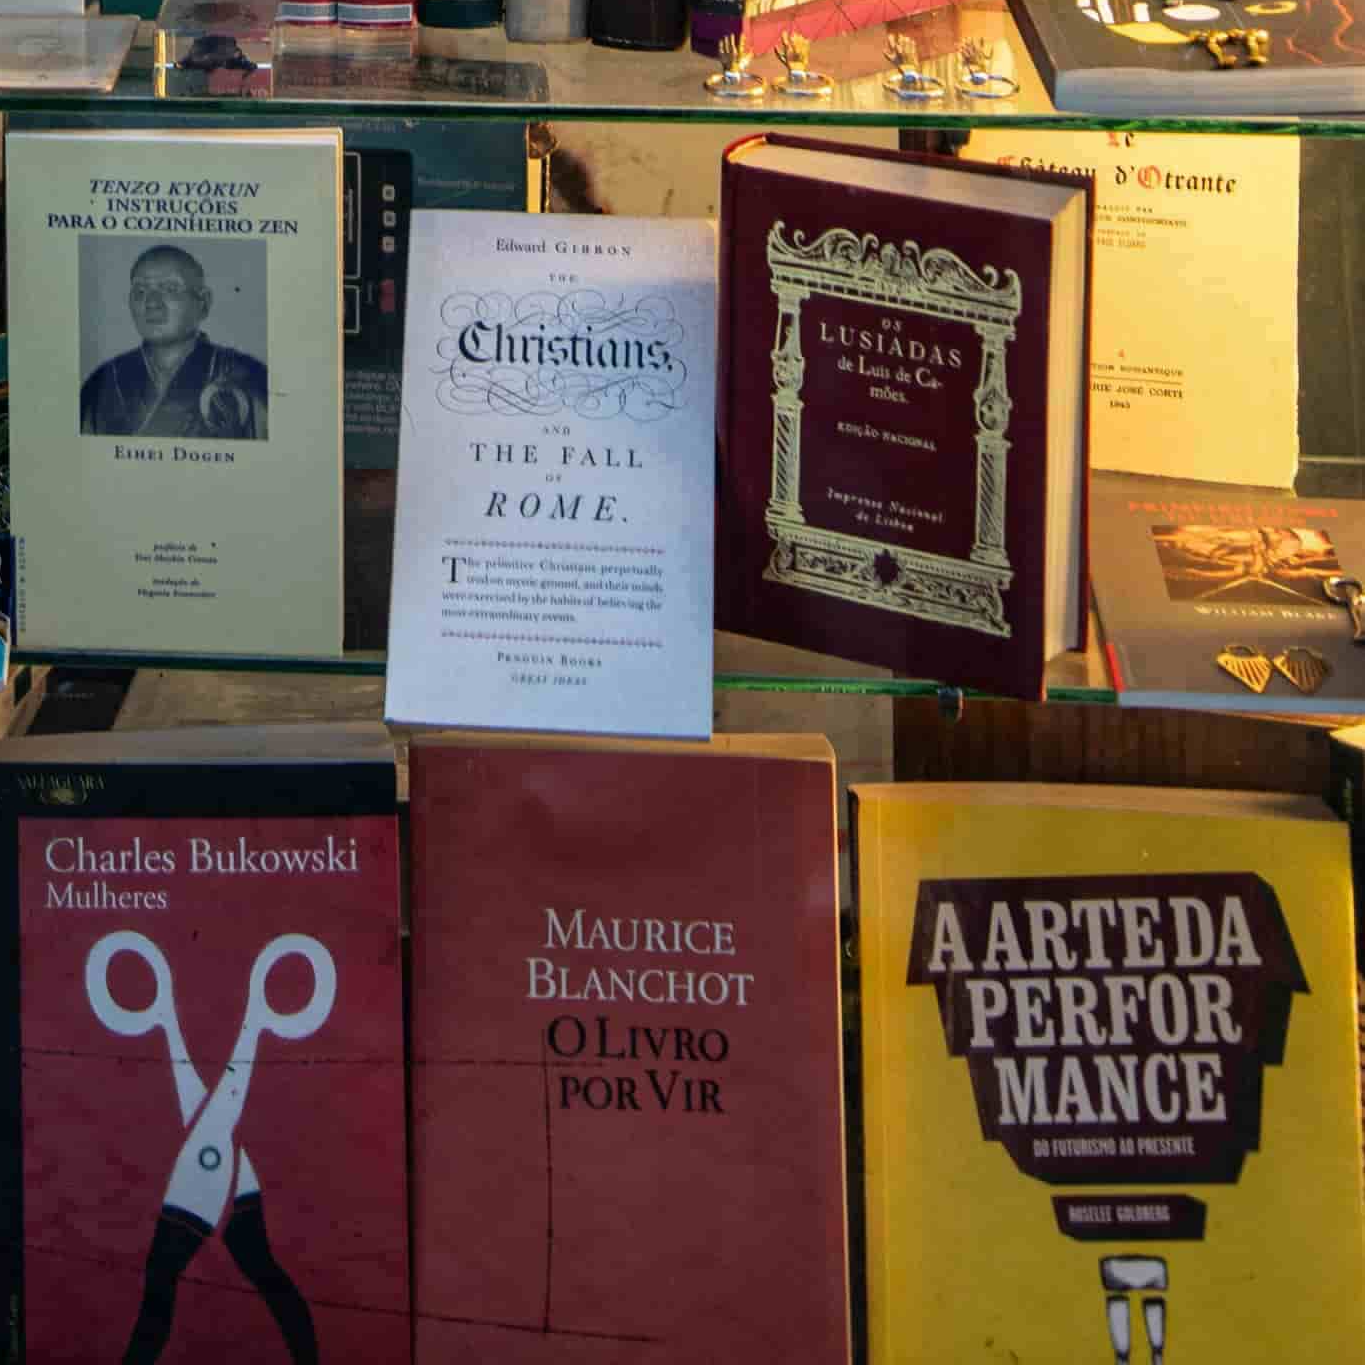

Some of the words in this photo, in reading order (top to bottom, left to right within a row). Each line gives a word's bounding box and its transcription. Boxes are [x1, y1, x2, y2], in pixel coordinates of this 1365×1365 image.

[46, 212, 104, 230] PARA
[106, 213, 120, 230] O
[123, 213, 254, 235] COZINHEIRO
[258, 218, 299, 236] ZEN
[106, 195, 239, 220] INSTRUÇÕES
[494, 237, 547, 255] Edward
[554, 240, 633, 257] GIBBON
[548, 272, 579, 284] THE
[540, 425, 572, 437] AND
[172, 444, 236, 464] DOGEN
[469, 441, 540, 466] THE
[560, 444, 644, 470] FALL
[484, 490, 631, 524] ROME.
[44, 836, 177, 875] Charles
[189, 836, 361, 875] Bukowski
[44, 879, 170, 912] Mulheres
[540, 906, 737, 955] MAURICE
[927, 900, 973, 974] A
[980, 895, 1166, 972] ARTE
[1169, 895, 1264, 968] DA
[524, 956, 755, 1007] BLANCHOT
[964, 972, 1244, 1049] PERFOR
[547, 1014, 587, 1062] O
[594, 1014, 732, 1063] LIVRO
[558, 1075, 643, 1113] POR
[644, 1069, 725, 1115] VIR
[992, 1053, 1228, 1126] MANCE
